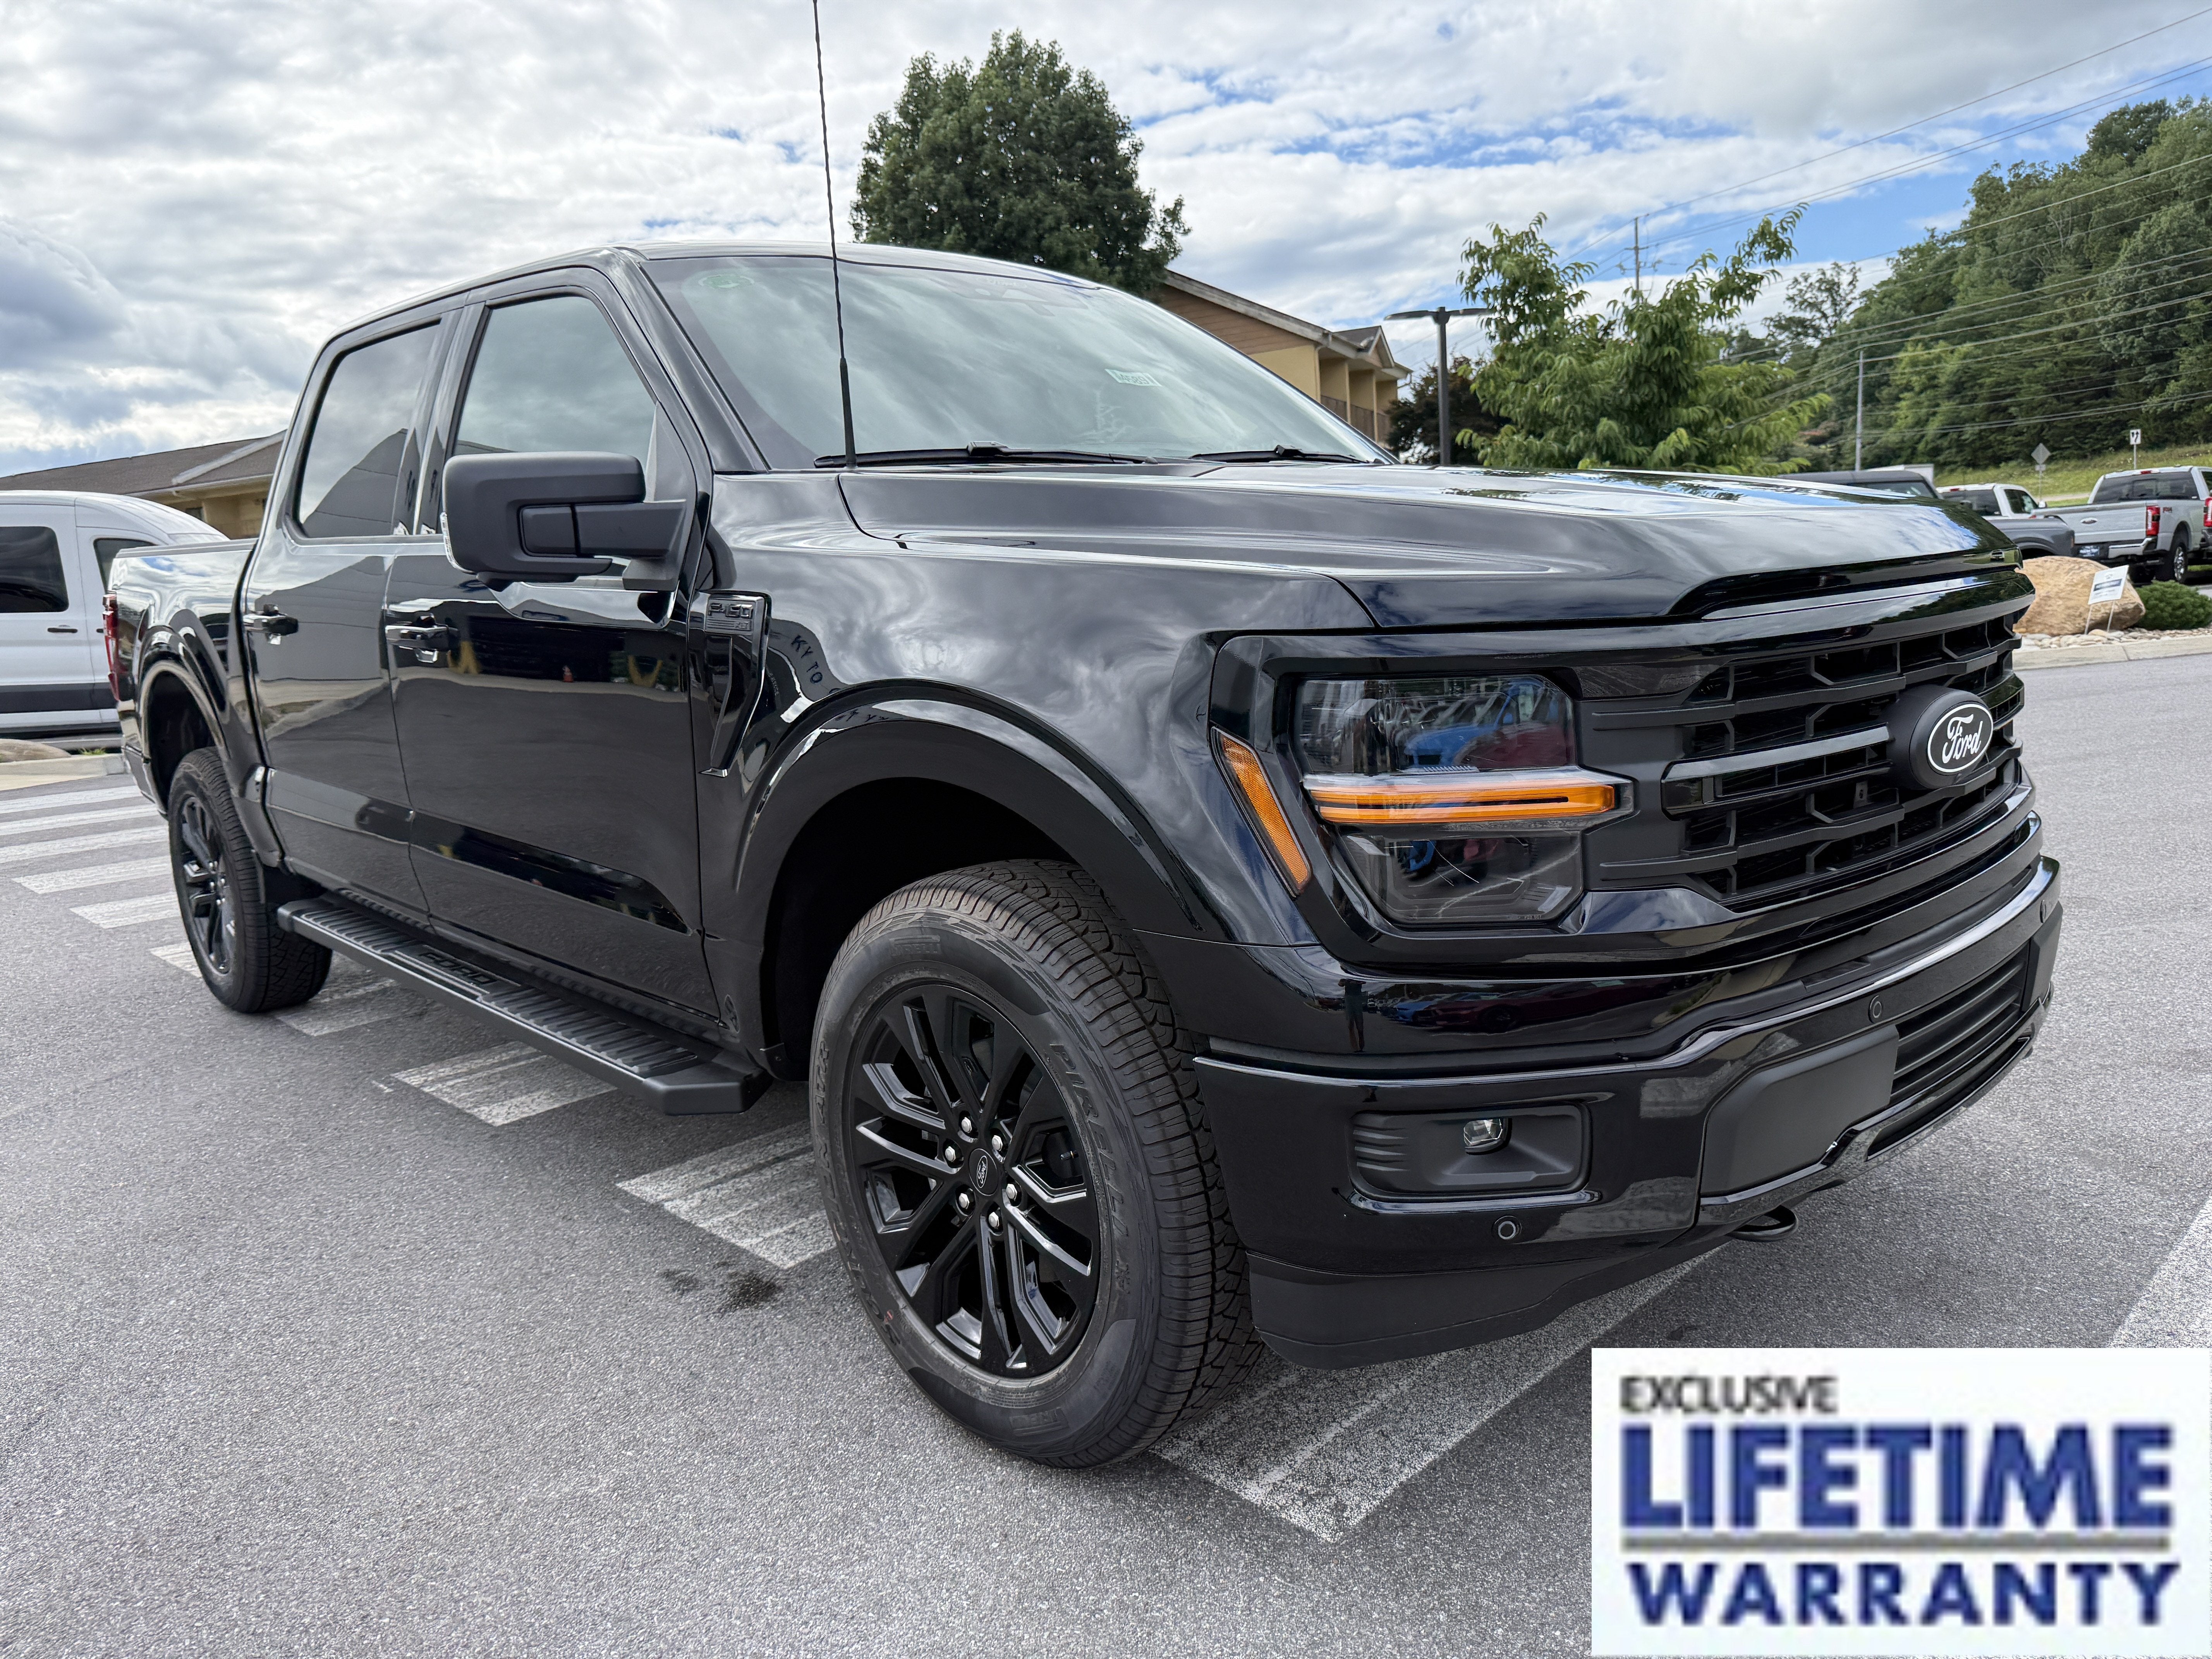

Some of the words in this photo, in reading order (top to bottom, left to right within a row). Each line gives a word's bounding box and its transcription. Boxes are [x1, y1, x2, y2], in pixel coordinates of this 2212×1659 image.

[1942, 714, 1983, 764] Ford
[418, 952, 498, 986] FORD
[1049, 1043, 1129, 1237] PIRELLI
[977, 1160, 986, 1184] Ford
